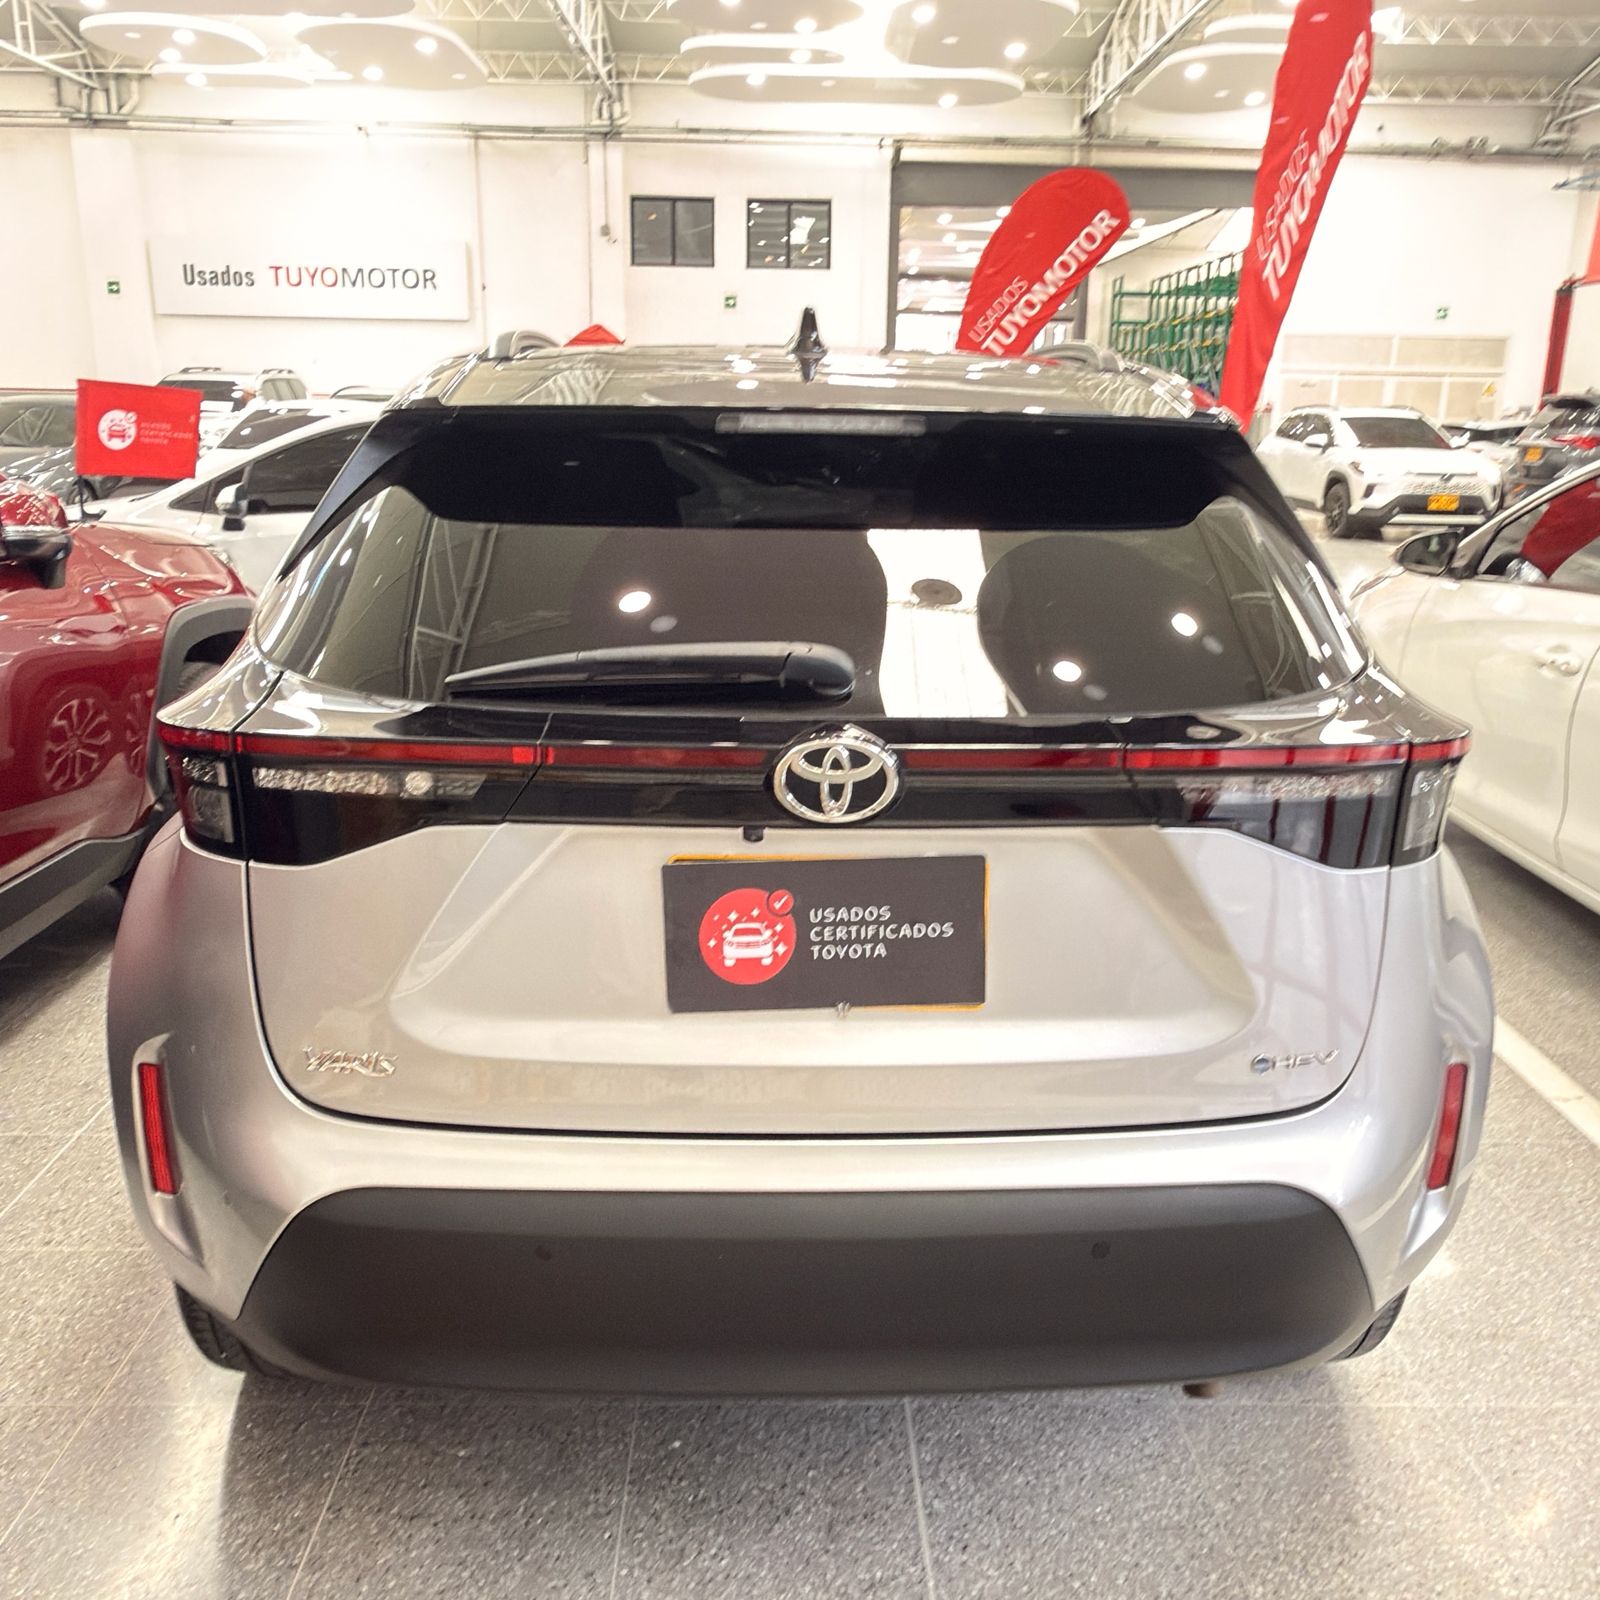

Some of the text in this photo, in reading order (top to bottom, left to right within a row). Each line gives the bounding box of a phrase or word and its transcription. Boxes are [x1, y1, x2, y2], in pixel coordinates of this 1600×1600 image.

[182, 263, 437, 290] Usados TUYOMOTOR
[980, 208, 1121, 356] TUYOMOTOR
[967, 275, 1029, 343] USADOS
[809, 905, 892, 924] USADOS
[809, 921, 955, 943] CERTIFICADOS
[810, 942, 888, 961] TOYOTA
[302, 1046, 398, 1077] YARIS
